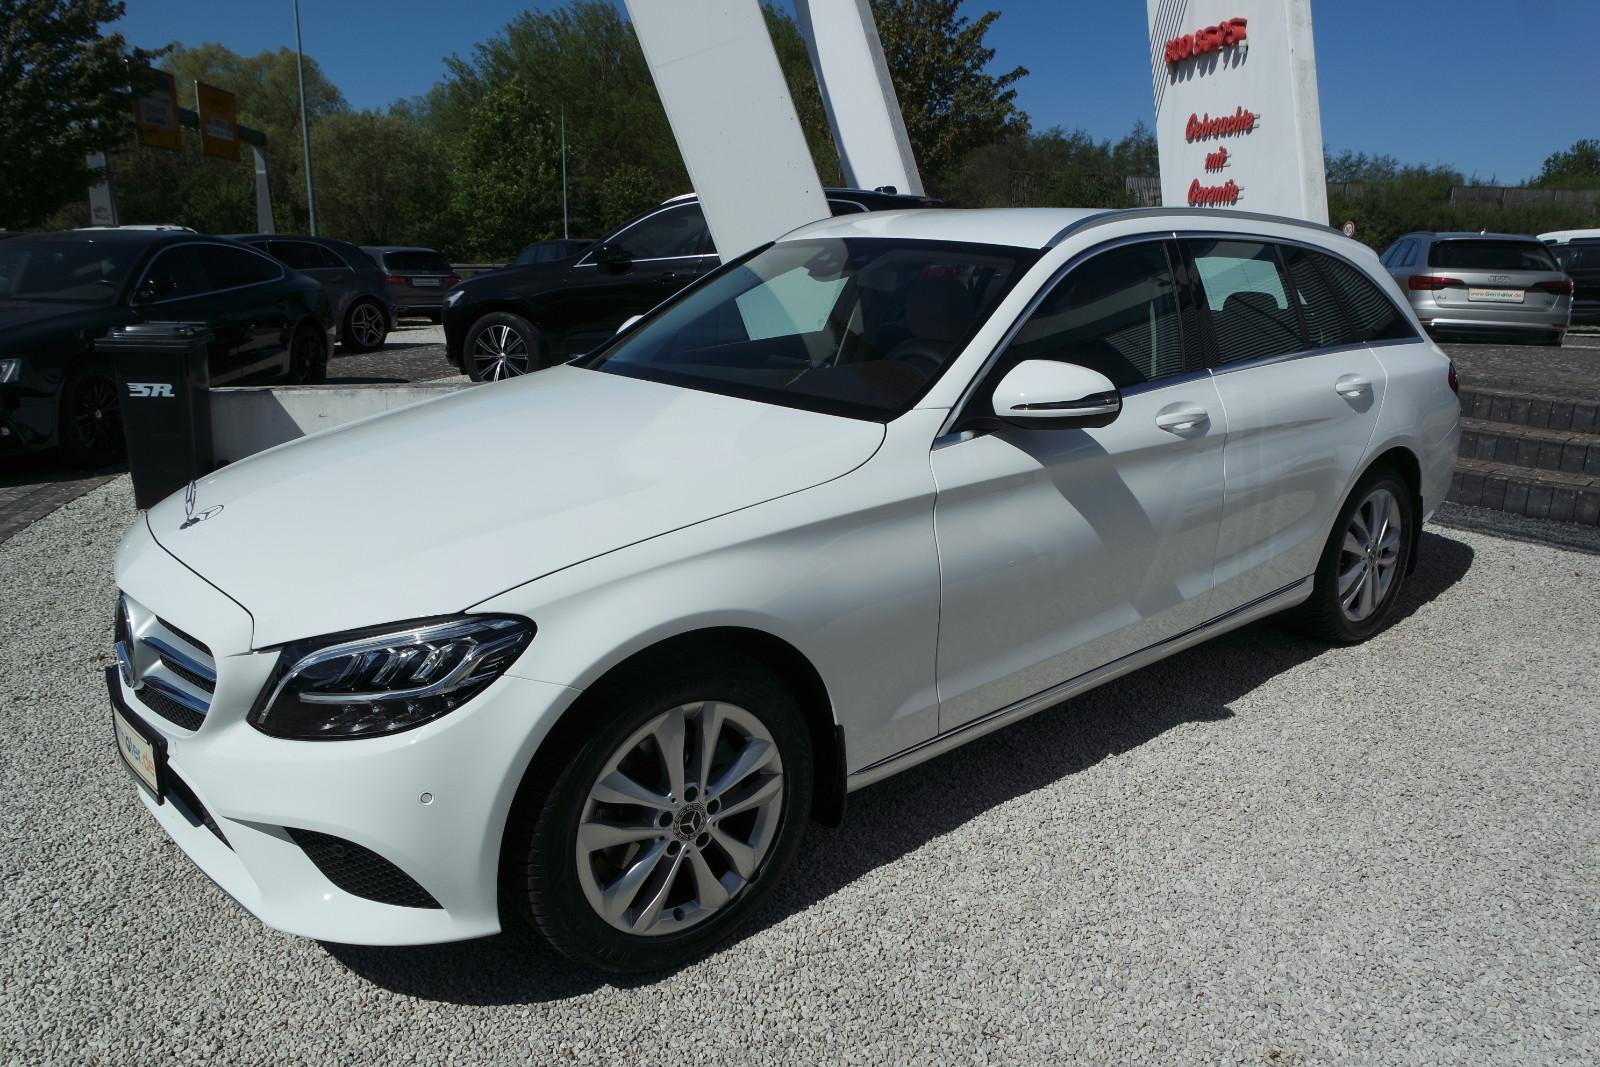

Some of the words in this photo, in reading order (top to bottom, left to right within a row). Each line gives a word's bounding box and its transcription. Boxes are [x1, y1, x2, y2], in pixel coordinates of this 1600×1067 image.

[1186, 106, 1255, 139] Gebrauchte
[1205, 147, 1228, 169] mit
[1188, 178, 1240, 206] Garantie
